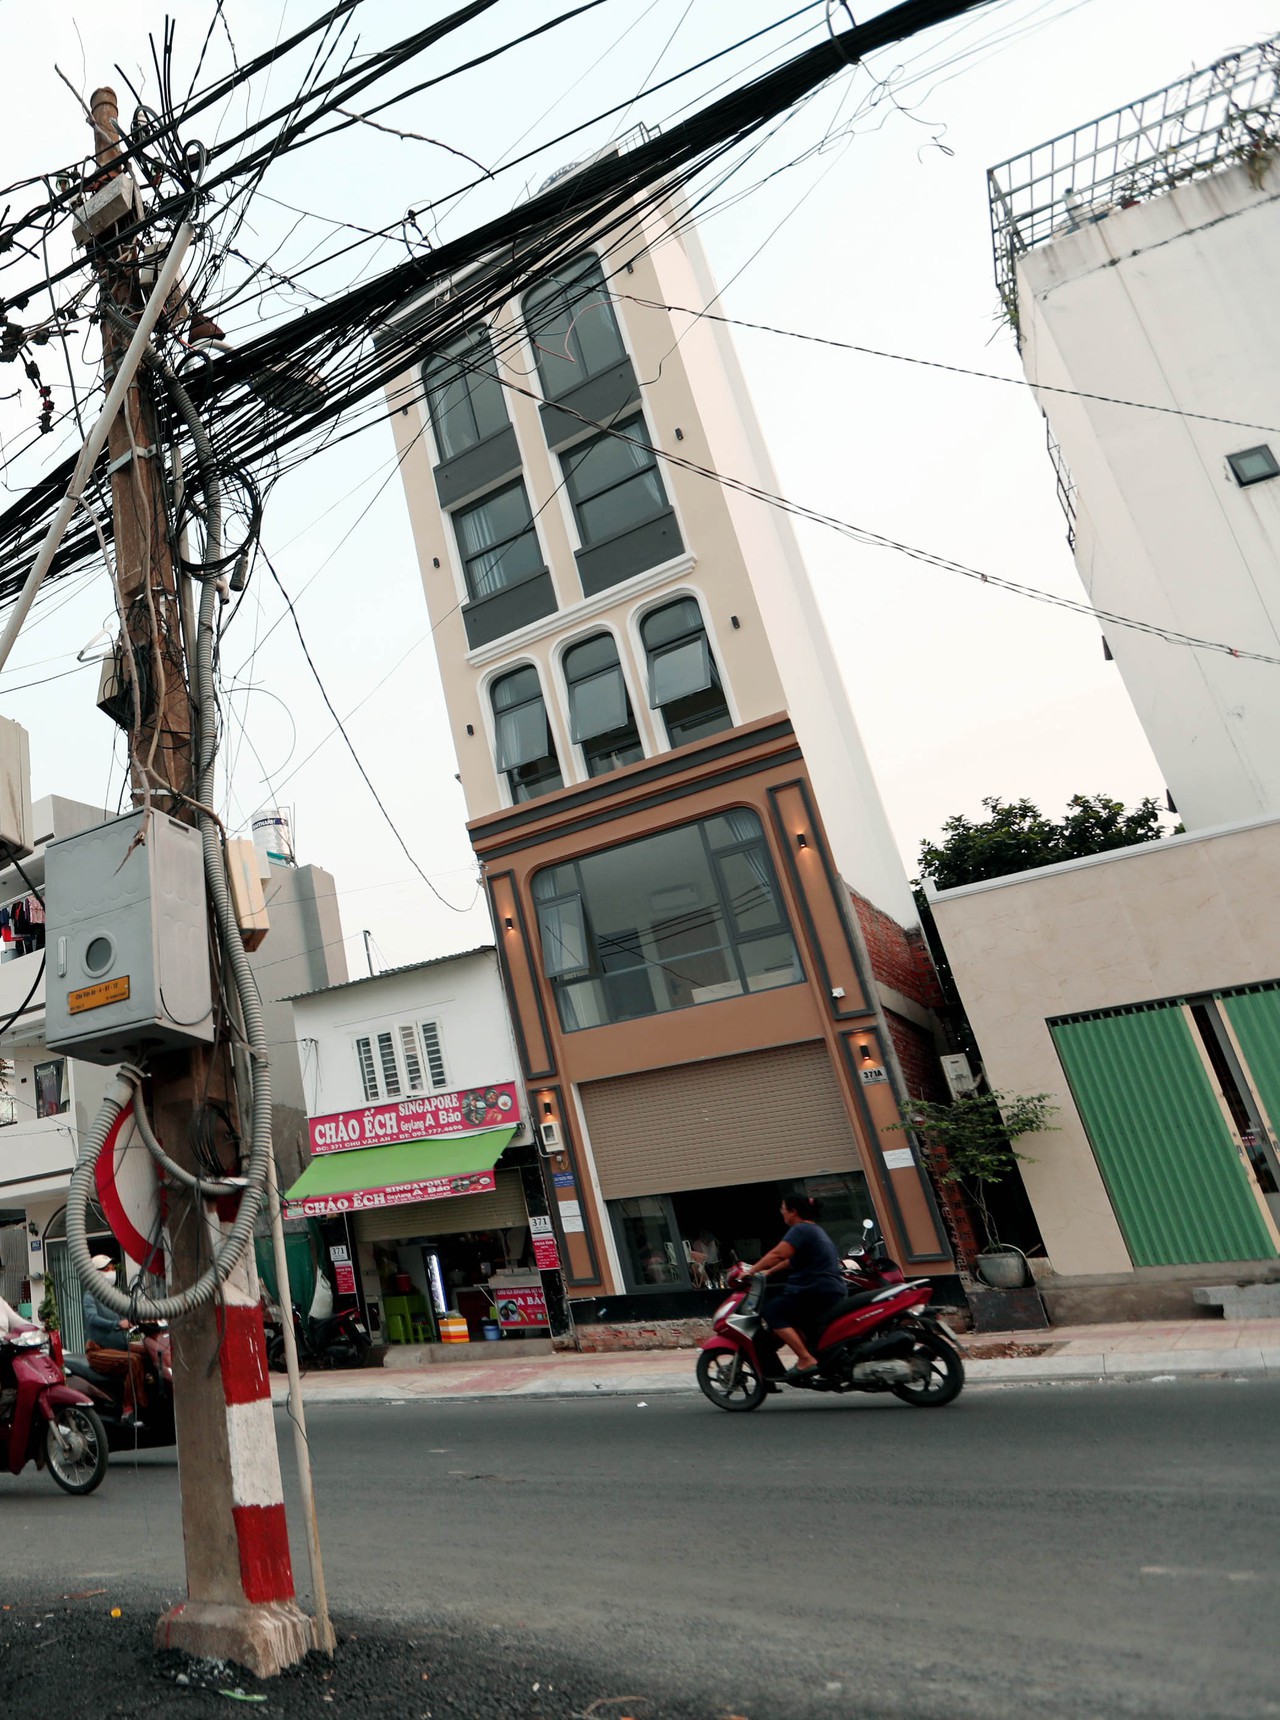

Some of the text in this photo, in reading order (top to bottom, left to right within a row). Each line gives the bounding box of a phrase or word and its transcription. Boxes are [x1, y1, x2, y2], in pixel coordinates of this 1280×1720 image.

[863, 1069, 883, 1079] 371A
[399, 1094, 459, 1116] SINGAPORE
[314, 1108, 399, 1145] CHÁO ẾCH
[401, 1108, 462, 1132] Geylang A Bảo
[385, 1179, 450, 1193] SINGAPORE
[304, 1197, 349, 1214] CHÁO
[352, 1191, 386, 1208] ẾCH
[532, 1217, 548, 1227] 371
[332, 1247, 345, 1255] 371
